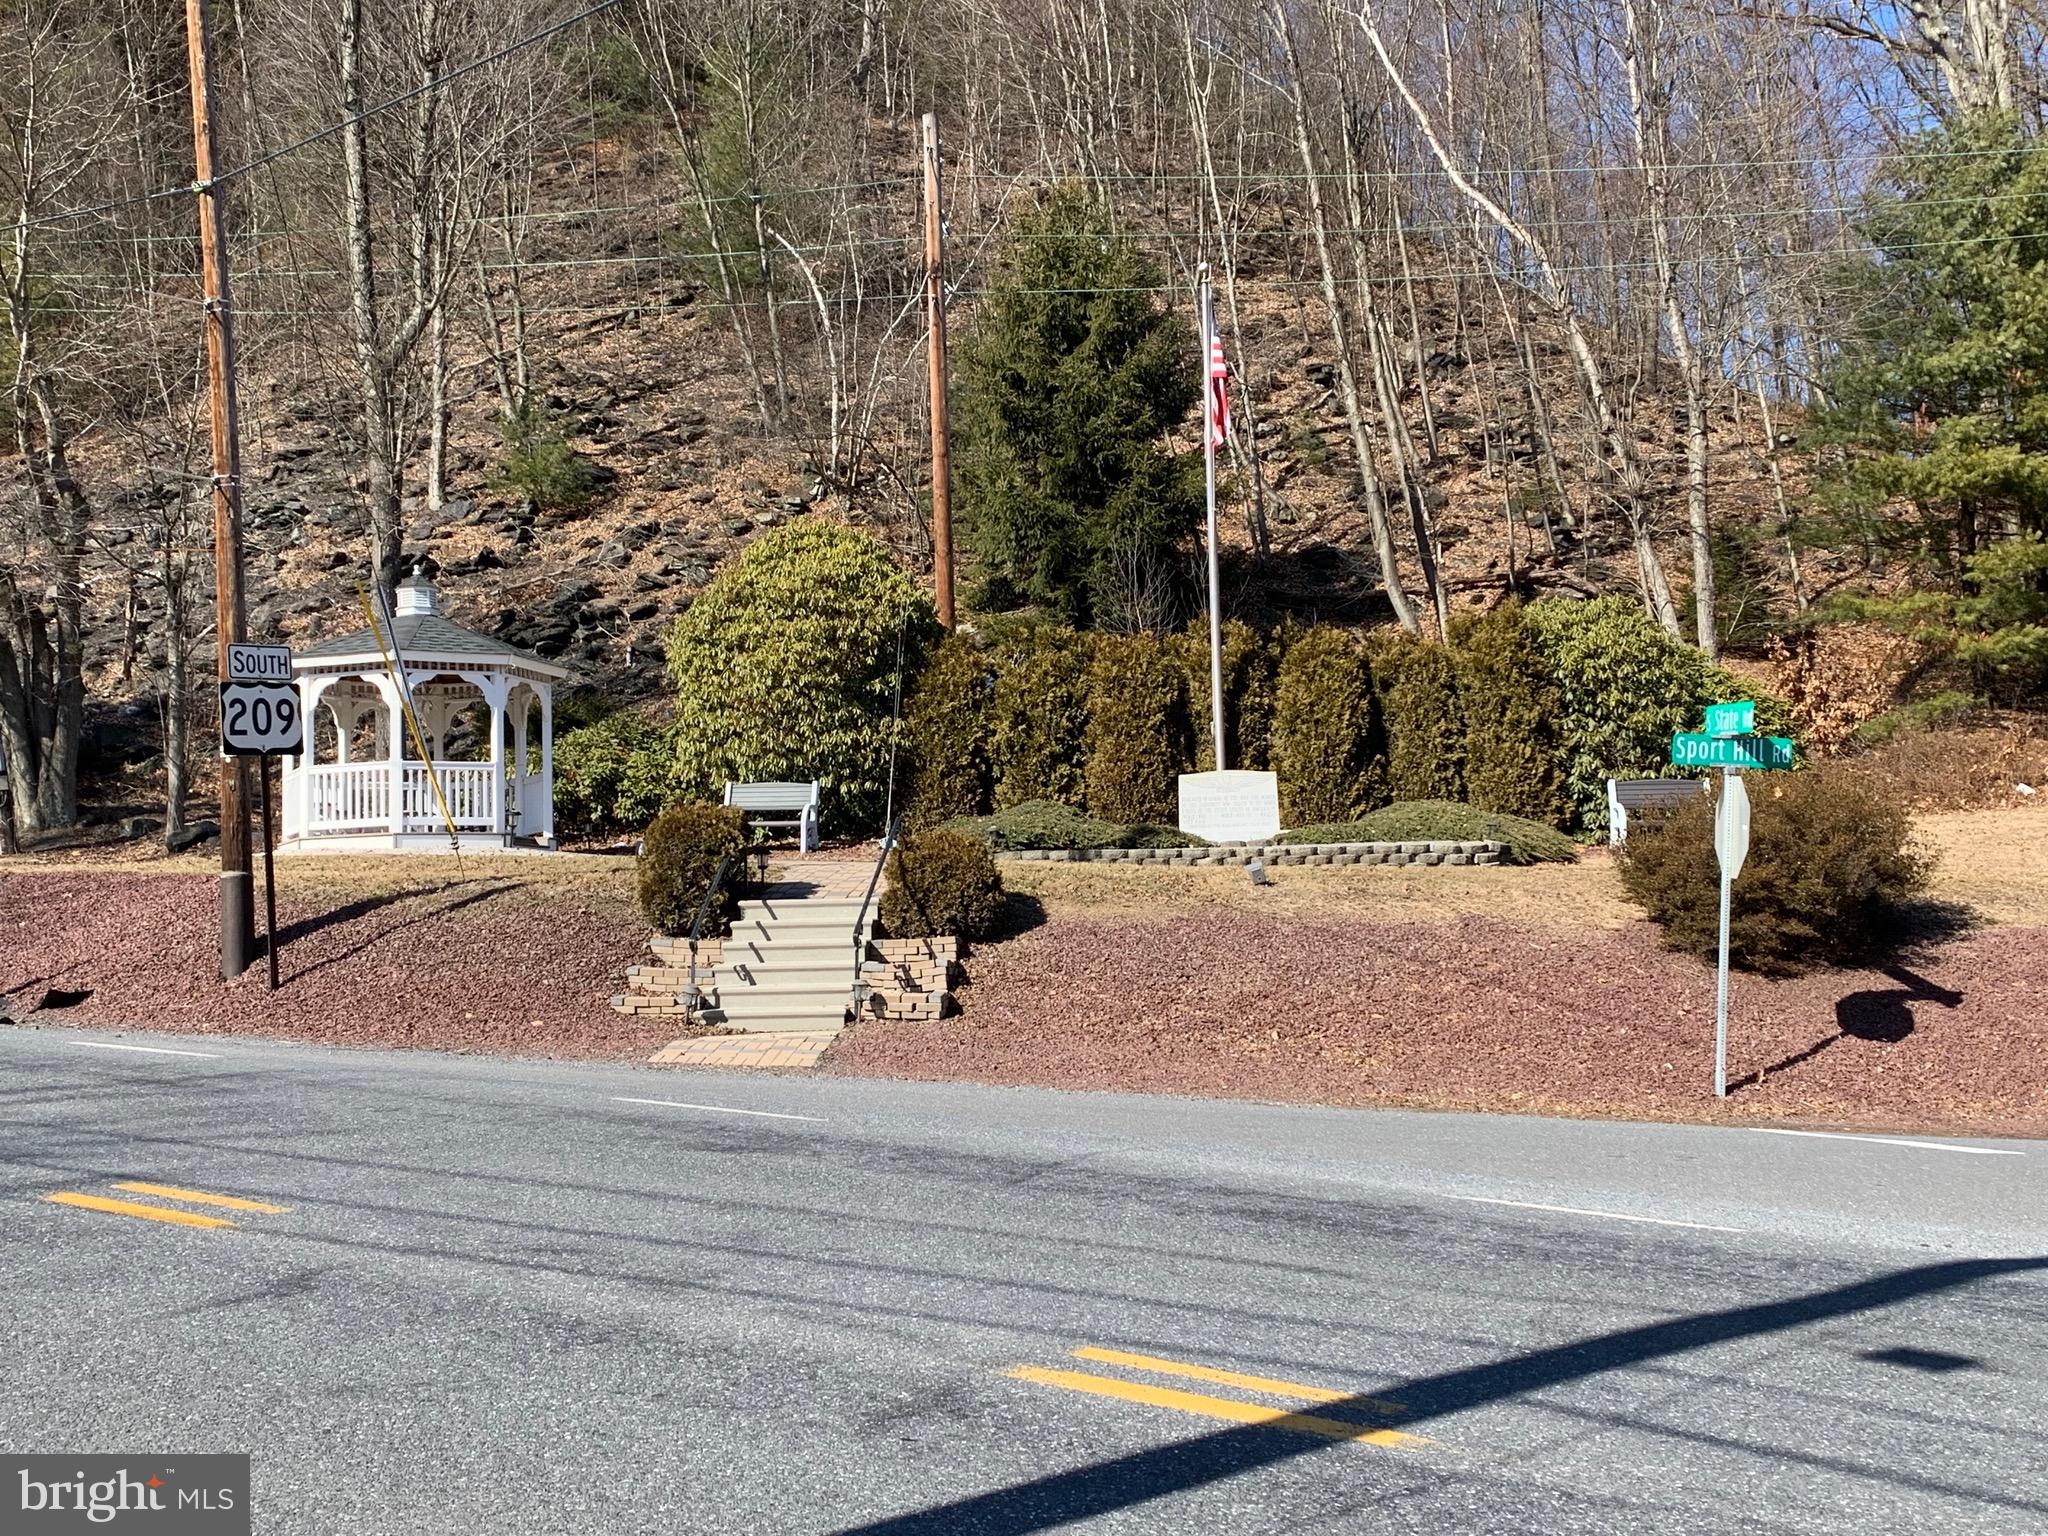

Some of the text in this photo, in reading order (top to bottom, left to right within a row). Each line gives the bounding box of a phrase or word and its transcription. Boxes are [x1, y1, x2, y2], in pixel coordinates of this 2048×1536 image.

[233, 650, 289, 675] SOUTH
[228, 697, 295, 736] 209
[1715, 708, 1740, 732] State
[1675, 736, 1791, 764] Sport Hill Rd
